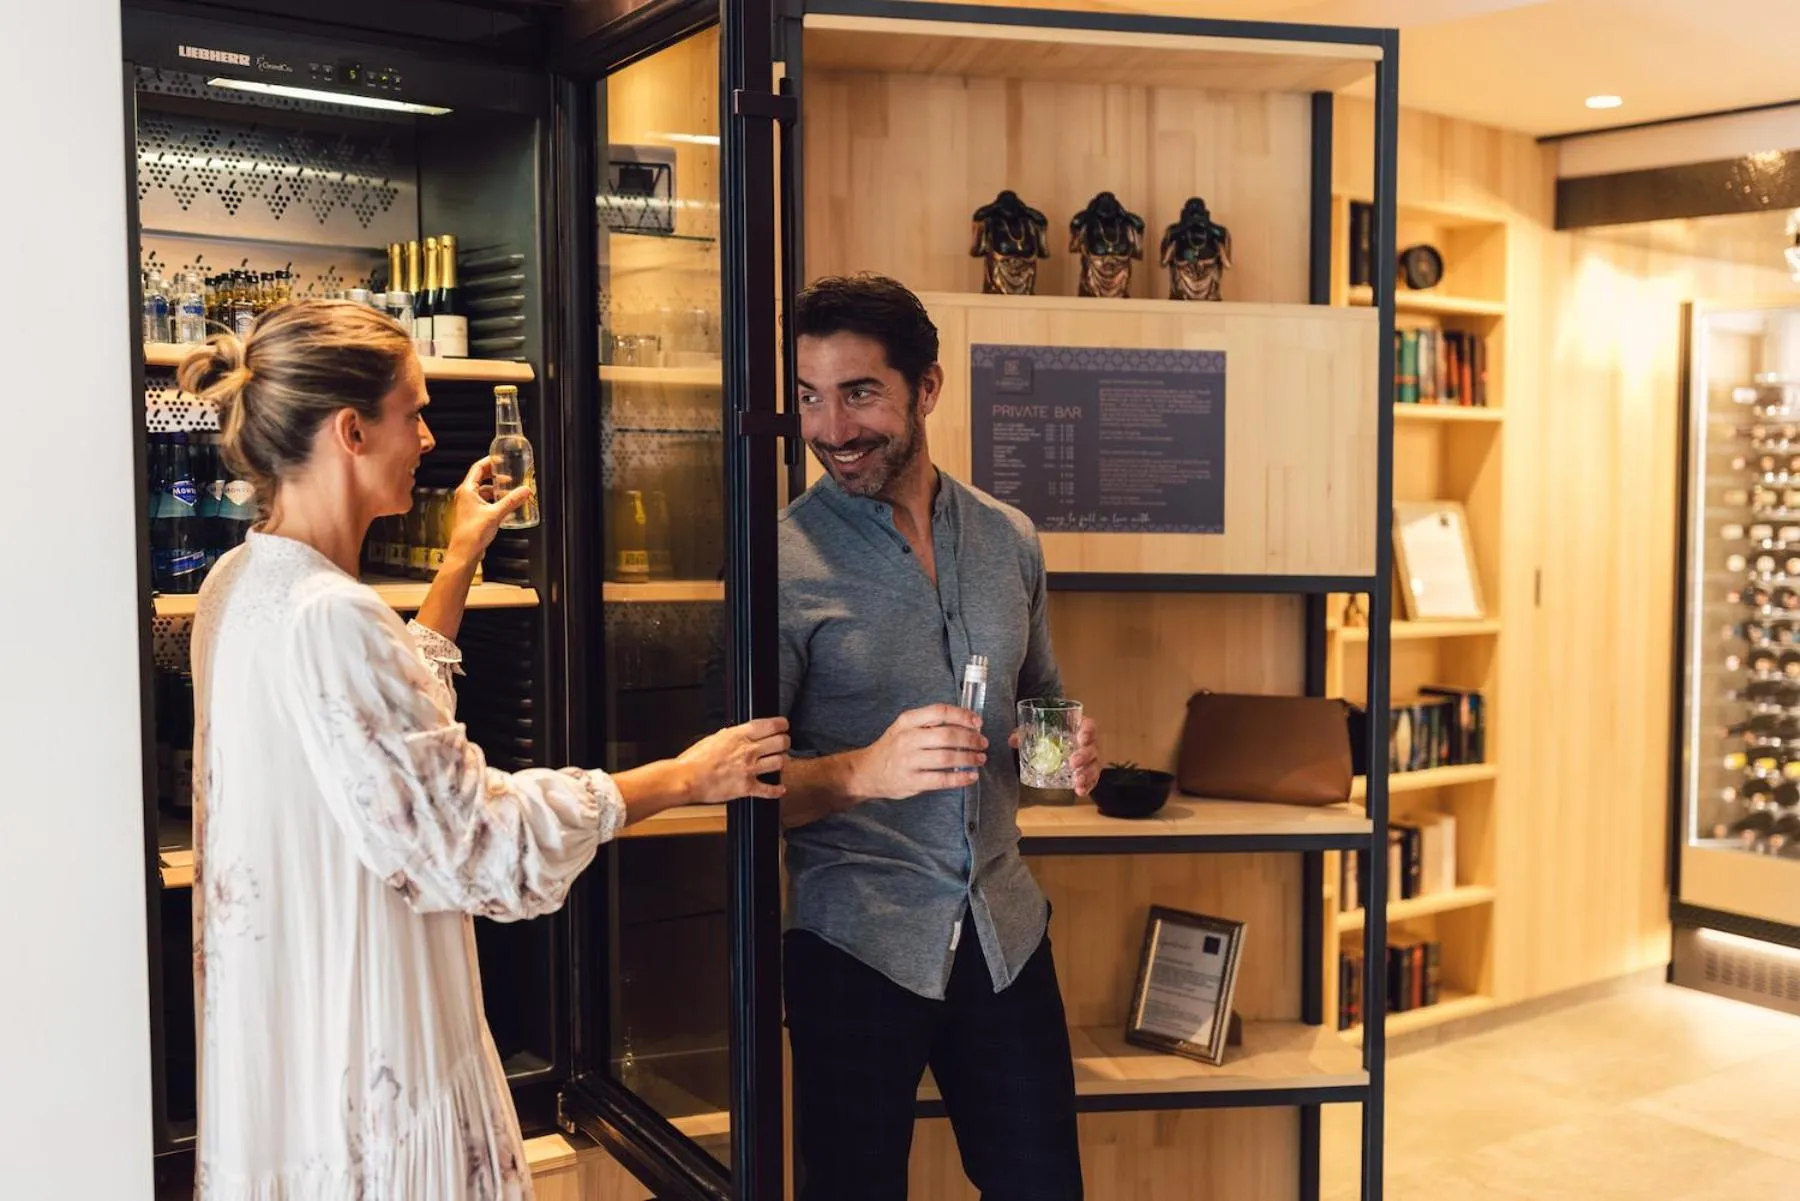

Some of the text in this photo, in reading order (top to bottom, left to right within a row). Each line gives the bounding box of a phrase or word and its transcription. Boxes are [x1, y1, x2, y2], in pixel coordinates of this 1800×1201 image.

[178, 45, 251, 67] LIEBHERR
[992, 404, 1083, 419] PRIVATE BAR
